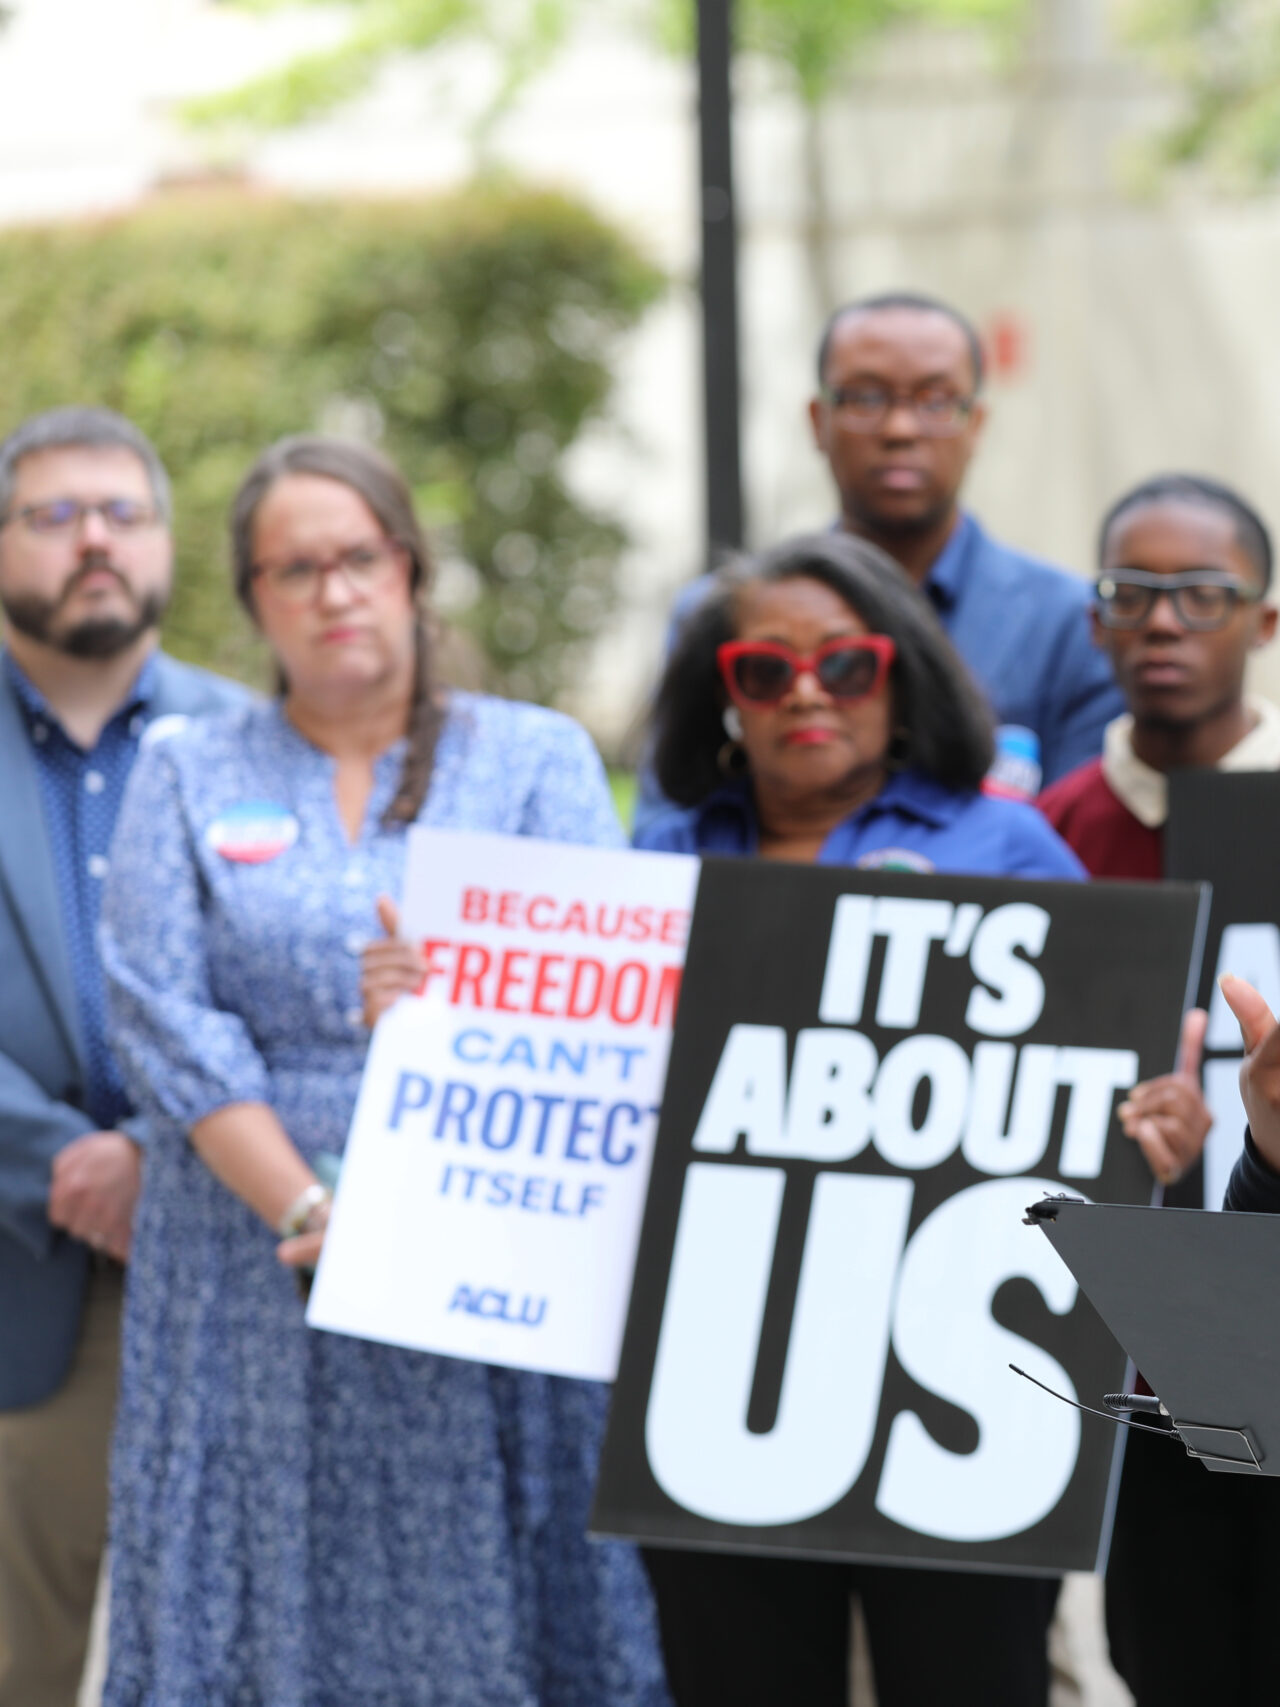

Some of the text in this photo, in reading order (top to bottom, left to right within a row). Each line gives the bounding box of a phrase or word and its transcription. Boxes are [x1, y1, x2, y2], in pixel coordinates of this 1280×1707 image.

[460, 885, 690, 945] BECAUSE
[819, 894, 1051, 1037] IT'S
[451, 1028, 648, 1081] CAN'T
[388, 1070, 661, 1167] PROTEC
[692, 1023, 1139, 1178] ABOUT
[438, 1163, 607, 1218] ITSELF
[447, 1283, 548, 1328] ACLU
[644, 1161, 1091, 1542] US
